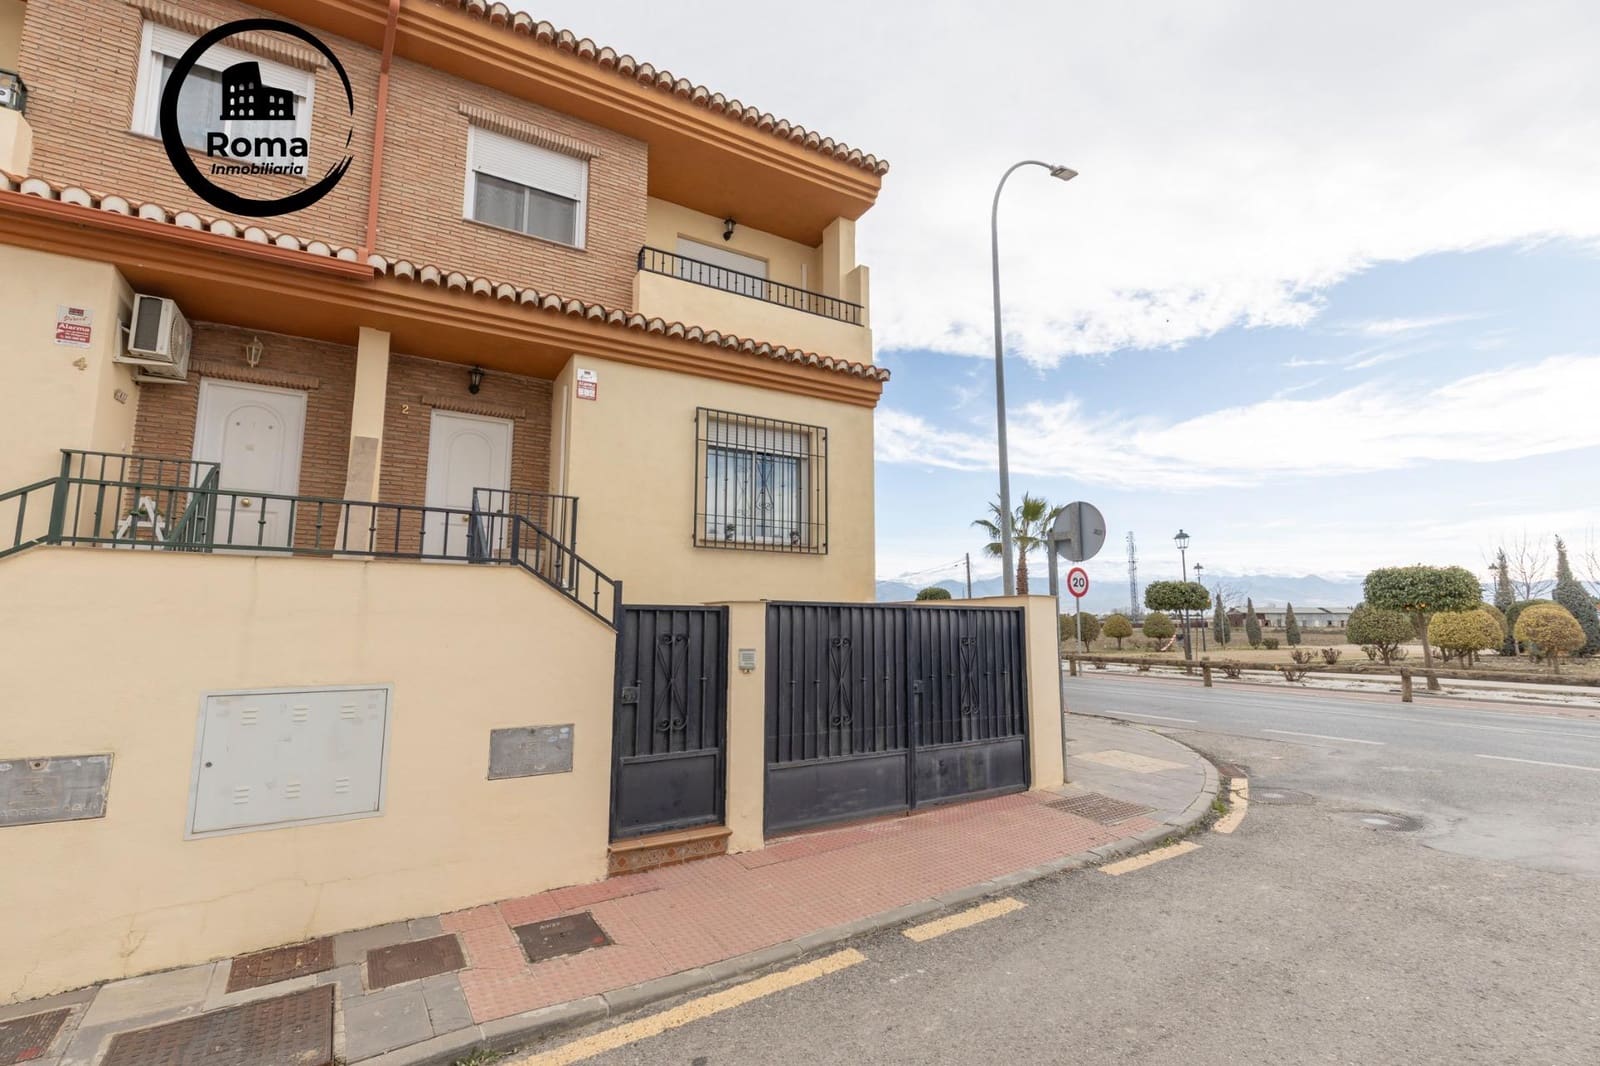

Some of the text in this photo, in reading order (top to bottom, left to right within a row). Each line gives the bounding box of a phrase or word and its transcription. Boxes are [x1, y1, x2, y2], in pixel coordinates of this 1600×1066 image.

[58, 323, 90, 332] Alarma
[402, 404, 409, 415] 2
[1072, 577, 1085, 588] 20
